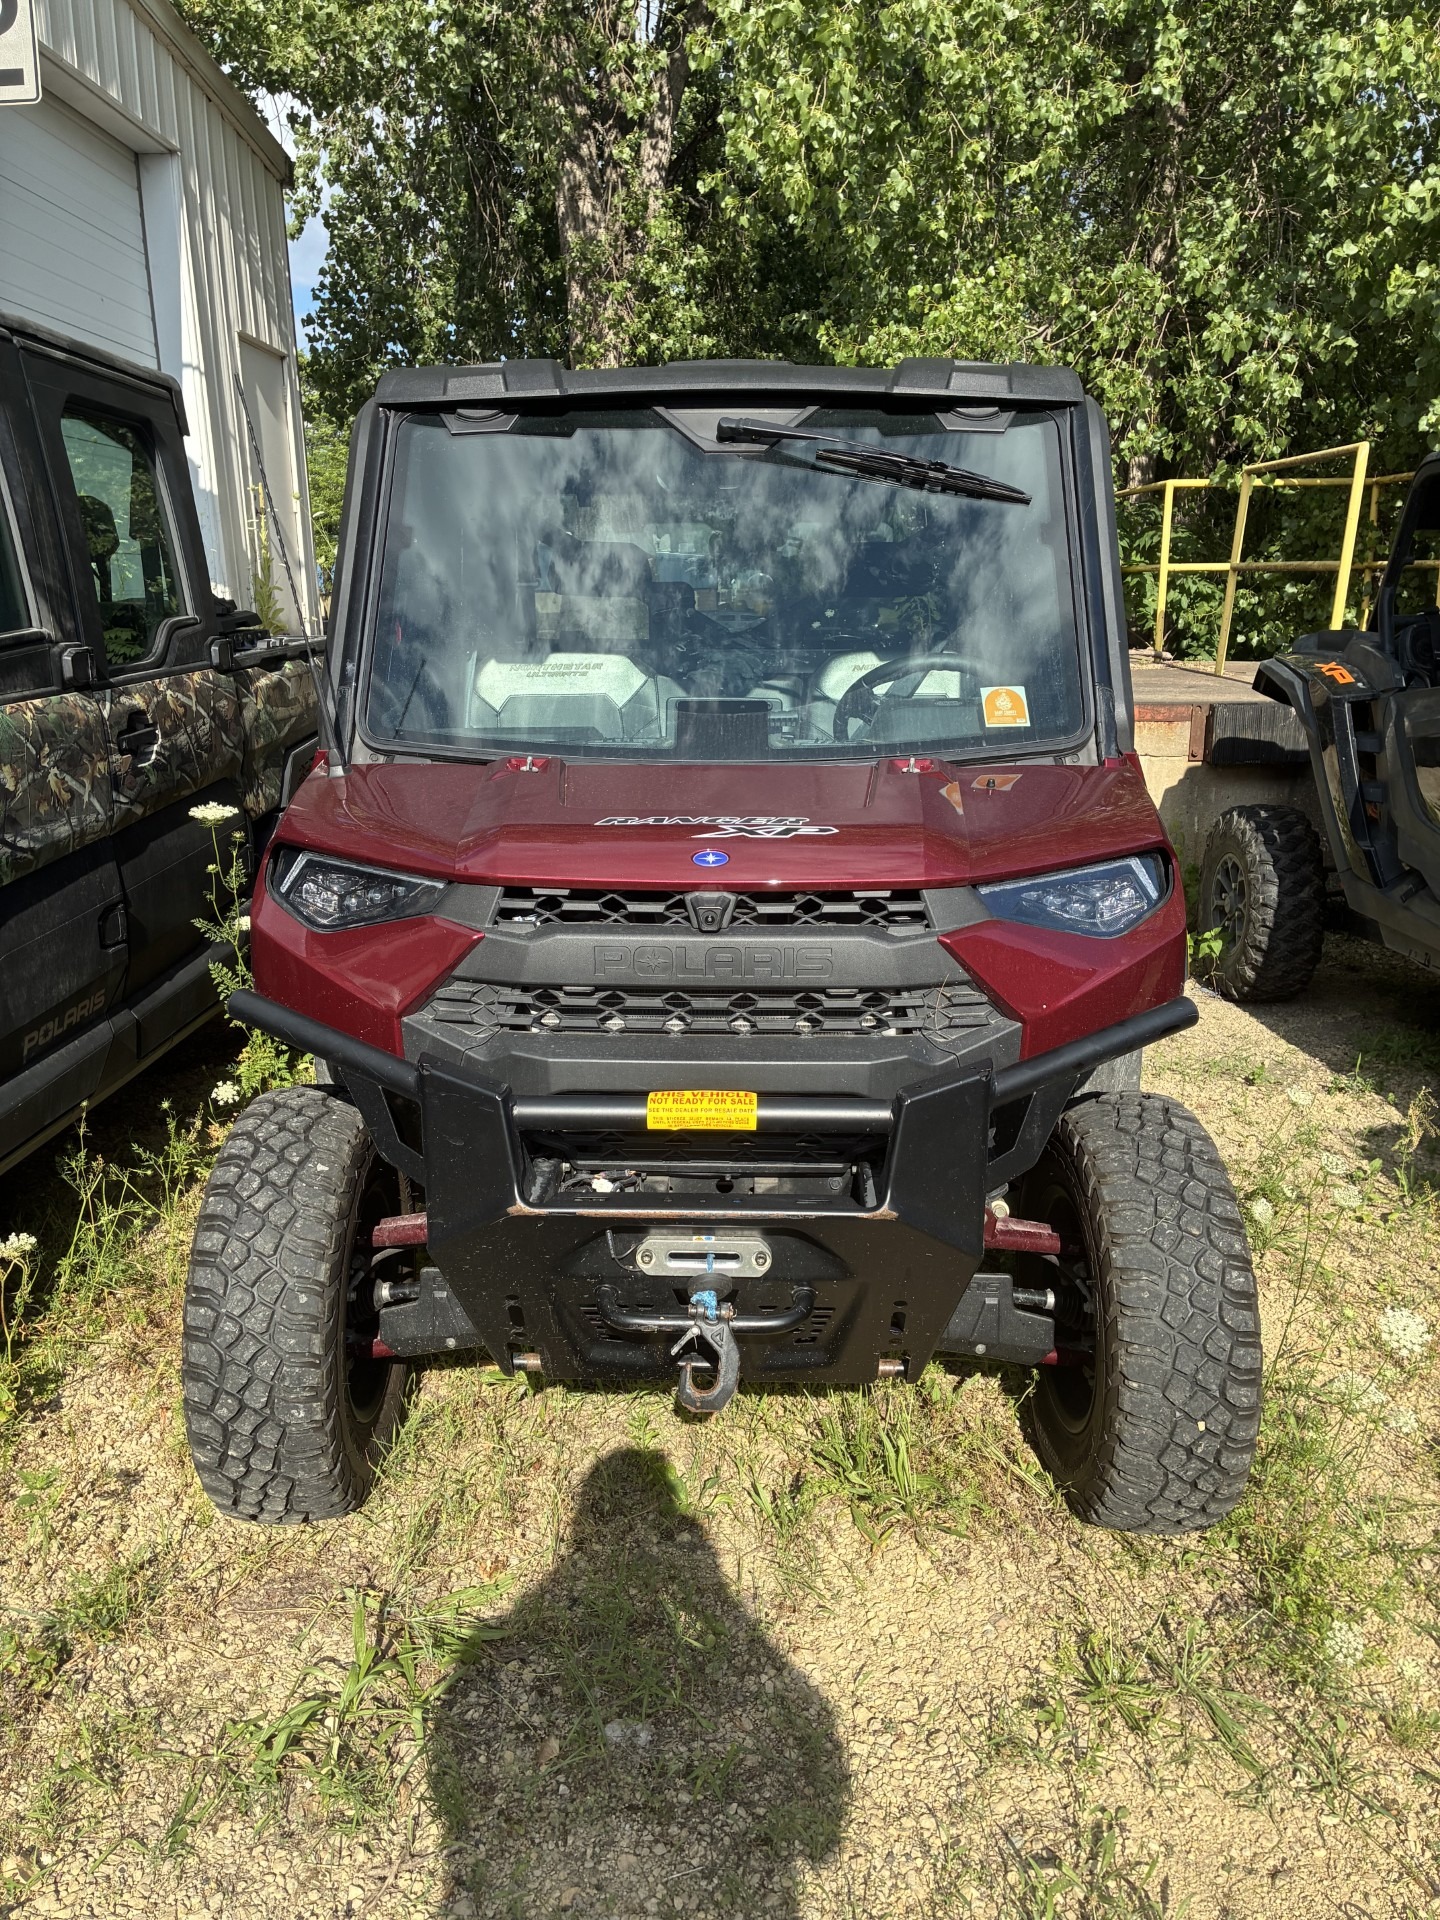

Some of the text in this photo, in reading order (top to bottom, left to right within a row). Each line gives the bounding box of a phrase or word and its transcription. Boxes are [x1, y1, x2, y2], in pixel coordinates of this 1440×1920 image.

[509, 662, 603, 672] NORTHSTAR
[1314, 661, 1356, 685] XP
[594, 816, 810, 825] RANGER
[690, 825, 839, 838] XP
[594, 946, 833, 977] POLARIS
[23, 988, 105, 1057] POLARIS
[691, 1091, 753, 1099] VEHICLE
[730, 1098, 754, 1106] SALE
